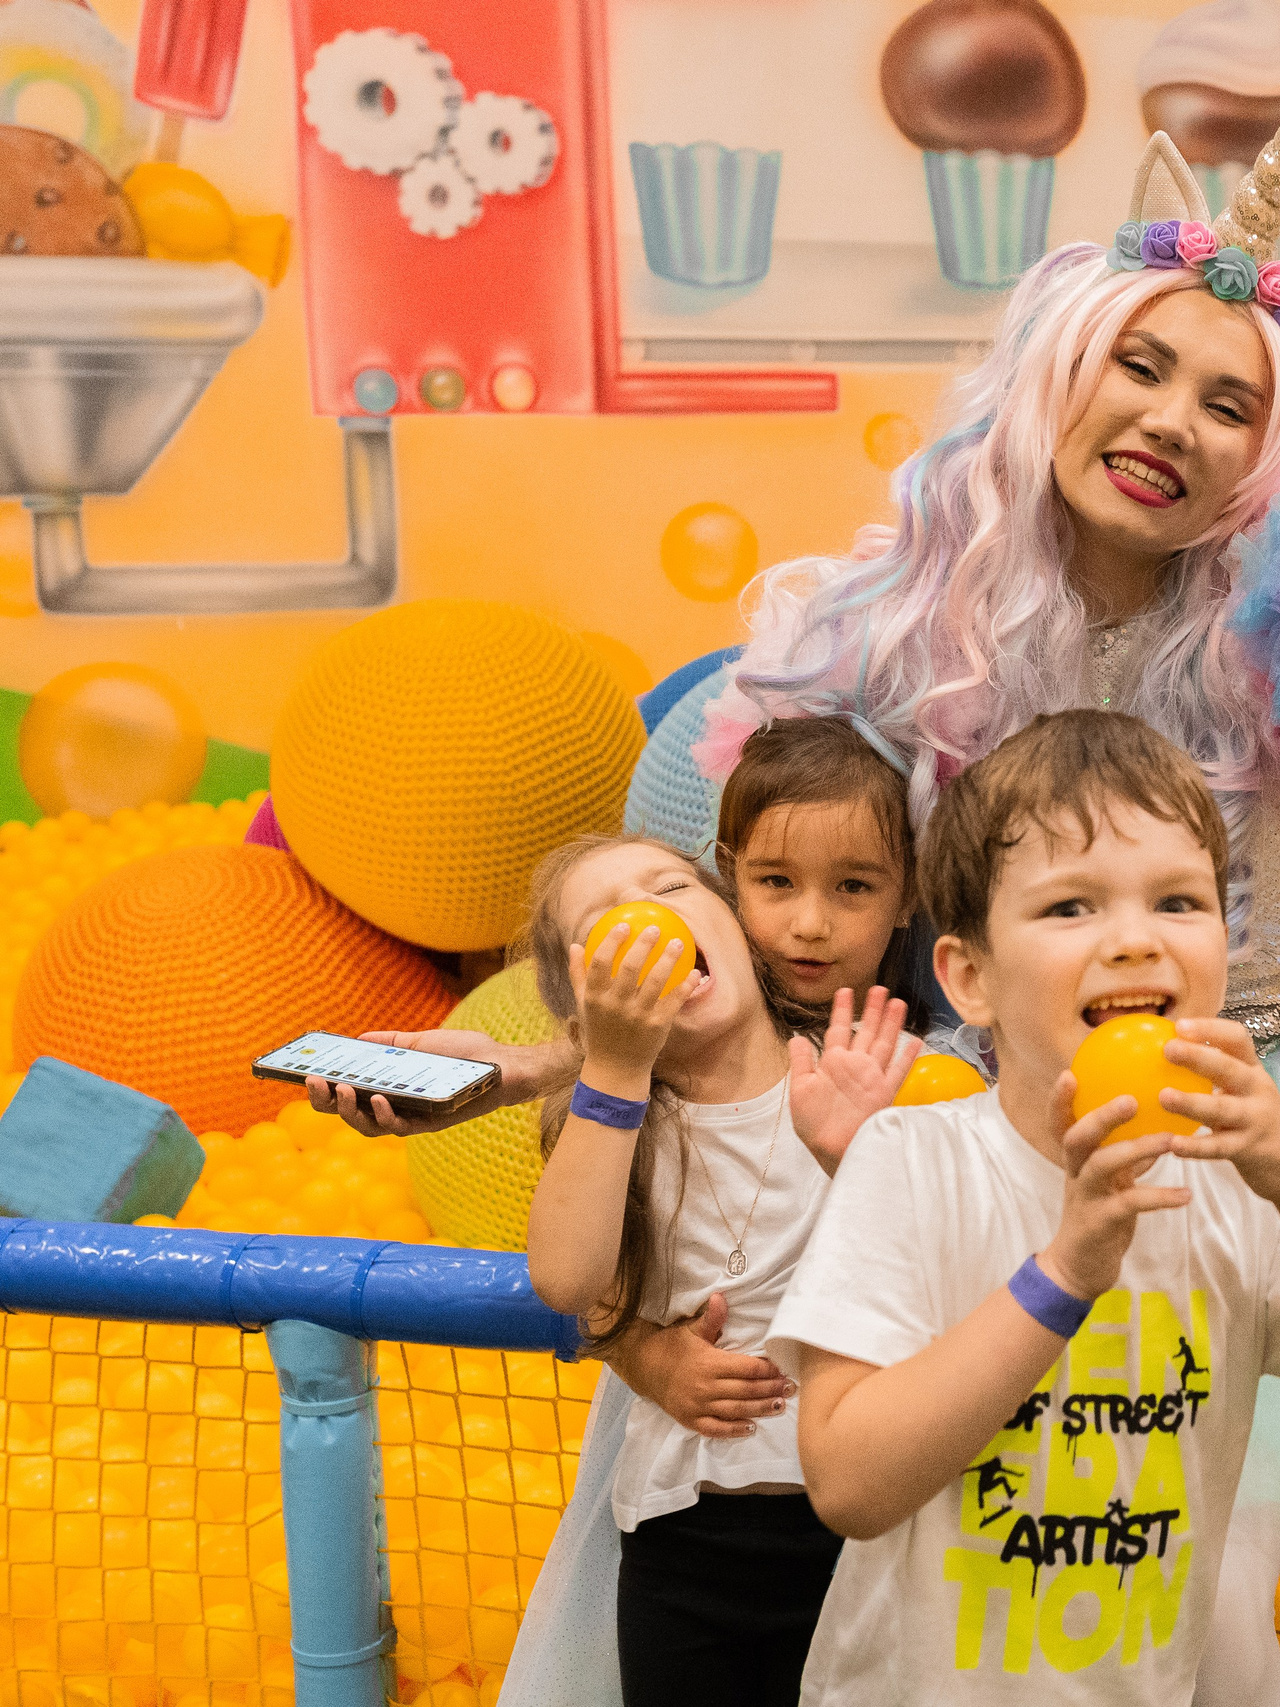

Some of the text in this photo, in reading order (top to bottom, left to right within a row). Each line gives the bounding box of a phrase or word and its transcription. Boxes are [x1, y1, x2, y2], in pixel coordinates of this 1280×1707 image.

[1034, 1288, 1212, 1406] EN
[1062, 1391, 1209, 1436] STREET
[1001, 1500, 1181, 1567] ARTIST
[943, 1541, 1194, 1675] TION
